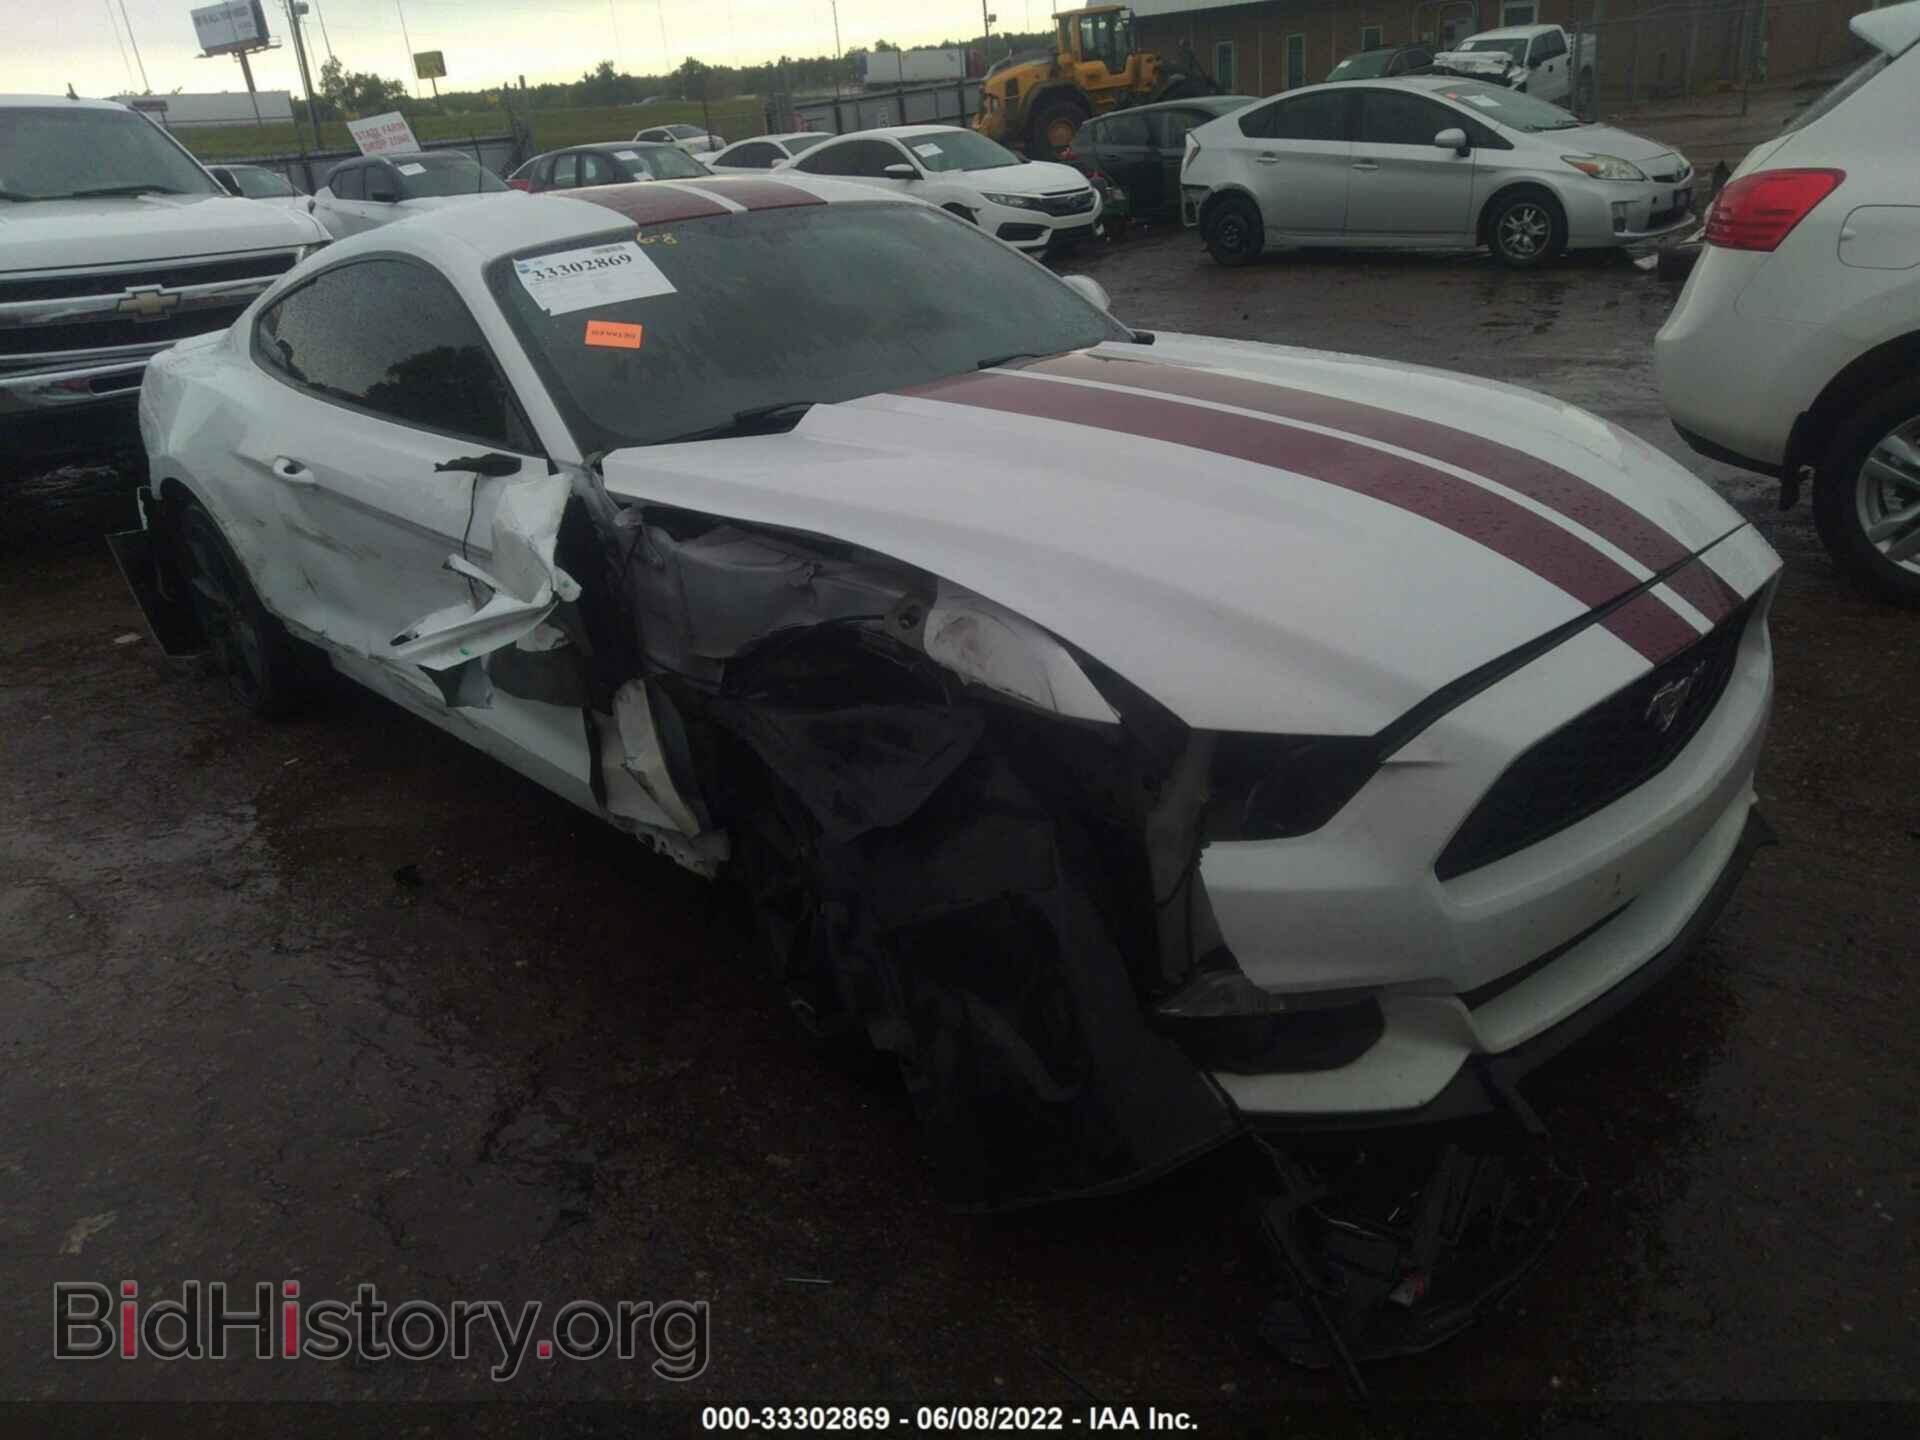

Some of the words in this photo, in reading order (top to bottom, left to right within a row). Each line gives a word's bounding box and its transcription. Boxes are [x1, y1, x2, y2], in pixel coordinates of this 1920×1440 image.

[353, 127, 381, 141] STATE
[383, 121, 406, 134] FARM
[531, 253, 633, 282] 33302869
